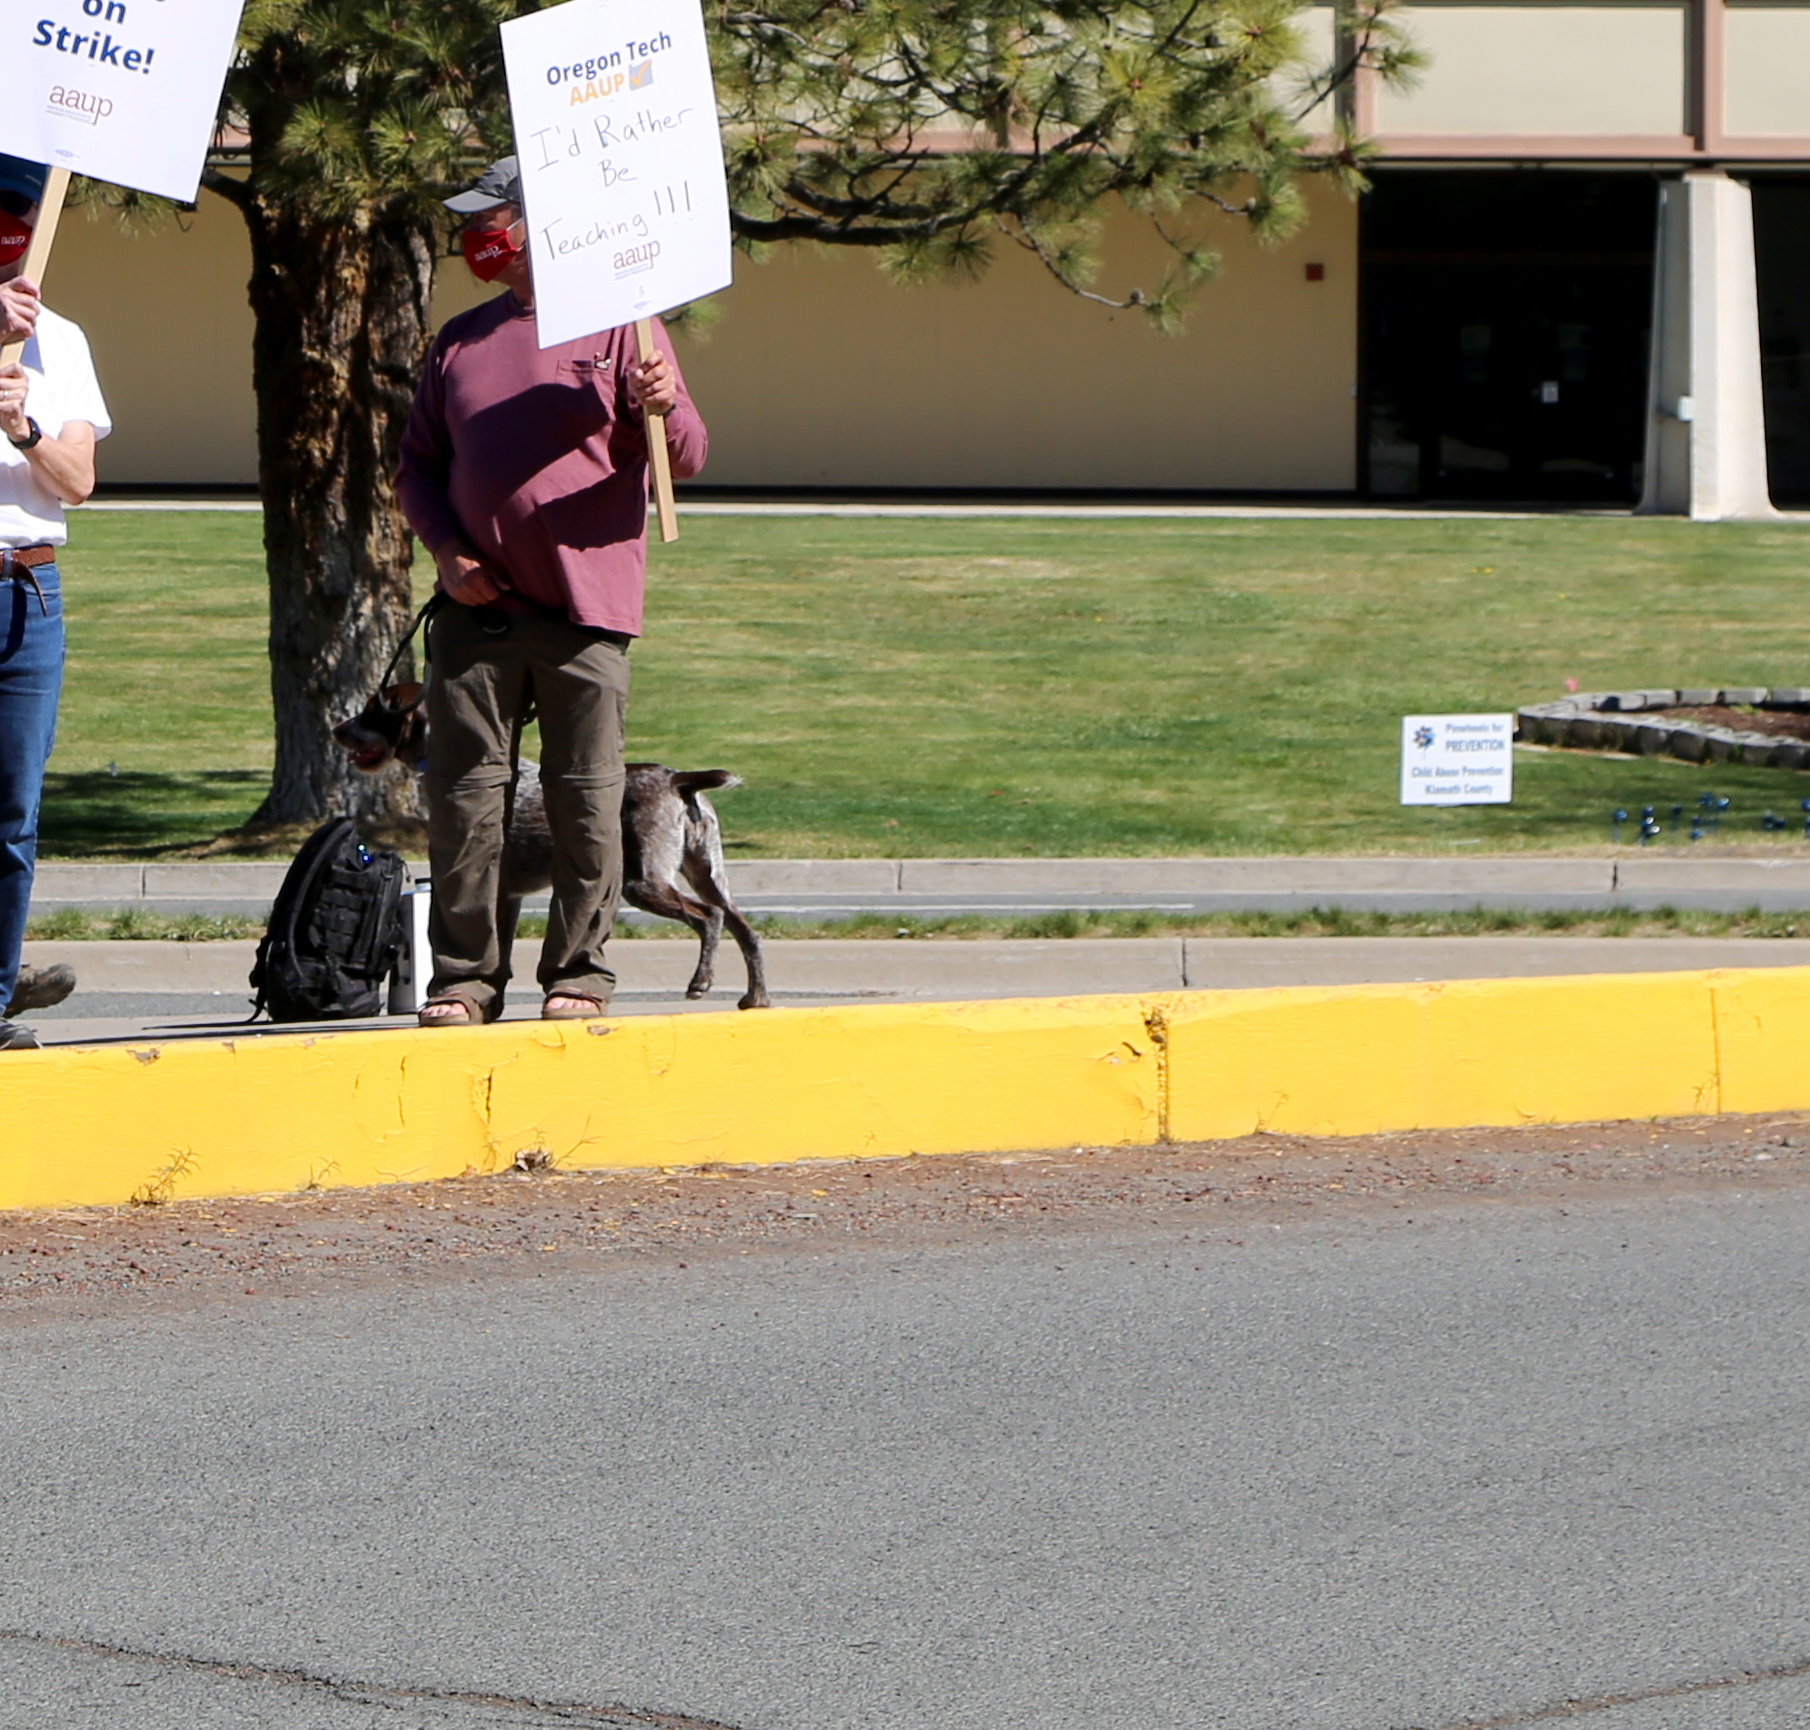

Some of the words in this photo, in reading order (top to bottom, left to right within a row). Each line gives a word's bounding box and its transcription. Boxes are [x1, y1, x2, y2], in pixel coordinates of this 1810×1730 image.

[32, 20, 155, 74] Strike!
[546, 47, 622, 86] Oregon
[626, 30, 672, 63] Tech
[49, 85, 113, 126] aaup
[569, 72, 626, 107] AAUP
[530, 127, 581, 171] I'd
[594, 108, 694, 148] Rather
[597, 159, 637, 188] Be
[540, 213, 648, 260] Teaching
[613, 238, 661, 271] aaup
[1446, 739, 1505, 752] PREVENTION
